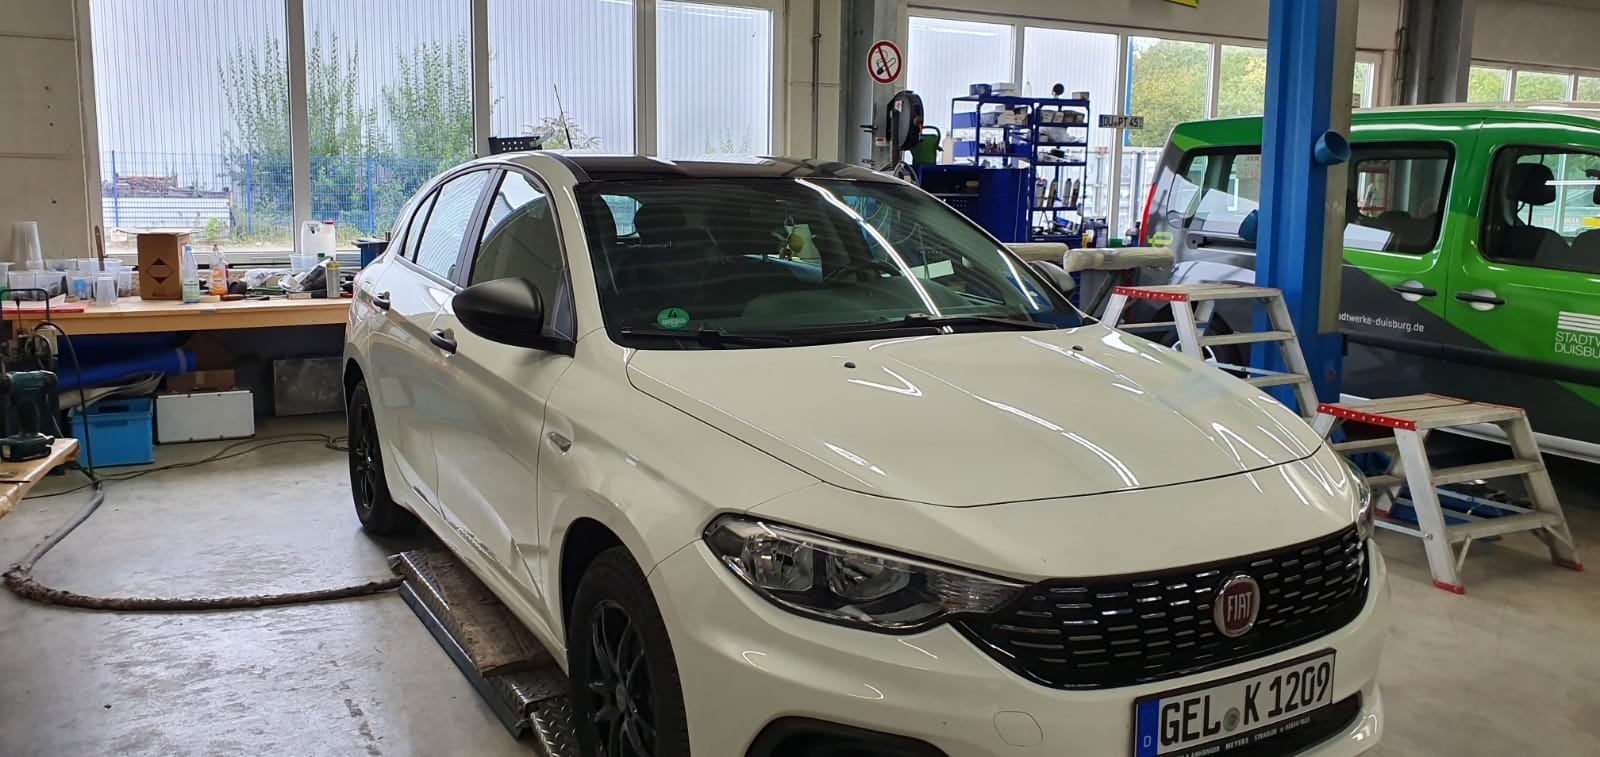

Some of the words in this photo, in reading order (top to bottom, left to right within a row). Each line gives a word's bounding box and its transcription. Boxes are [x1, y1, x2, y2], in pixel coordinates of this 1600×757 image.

[1103, 116, 1114, 127] DU
[1118, 117, 1129, 127] PT
[667, 308, 678, 319] 4
[1226, 590, 1254, 623] FIAT
[1160, 694, 1221, 747] GEL
[1243, 681, 1261, 726] K
[1268, 661, 1331, 719] 1209
[1143, 734, 1152, 748] D
